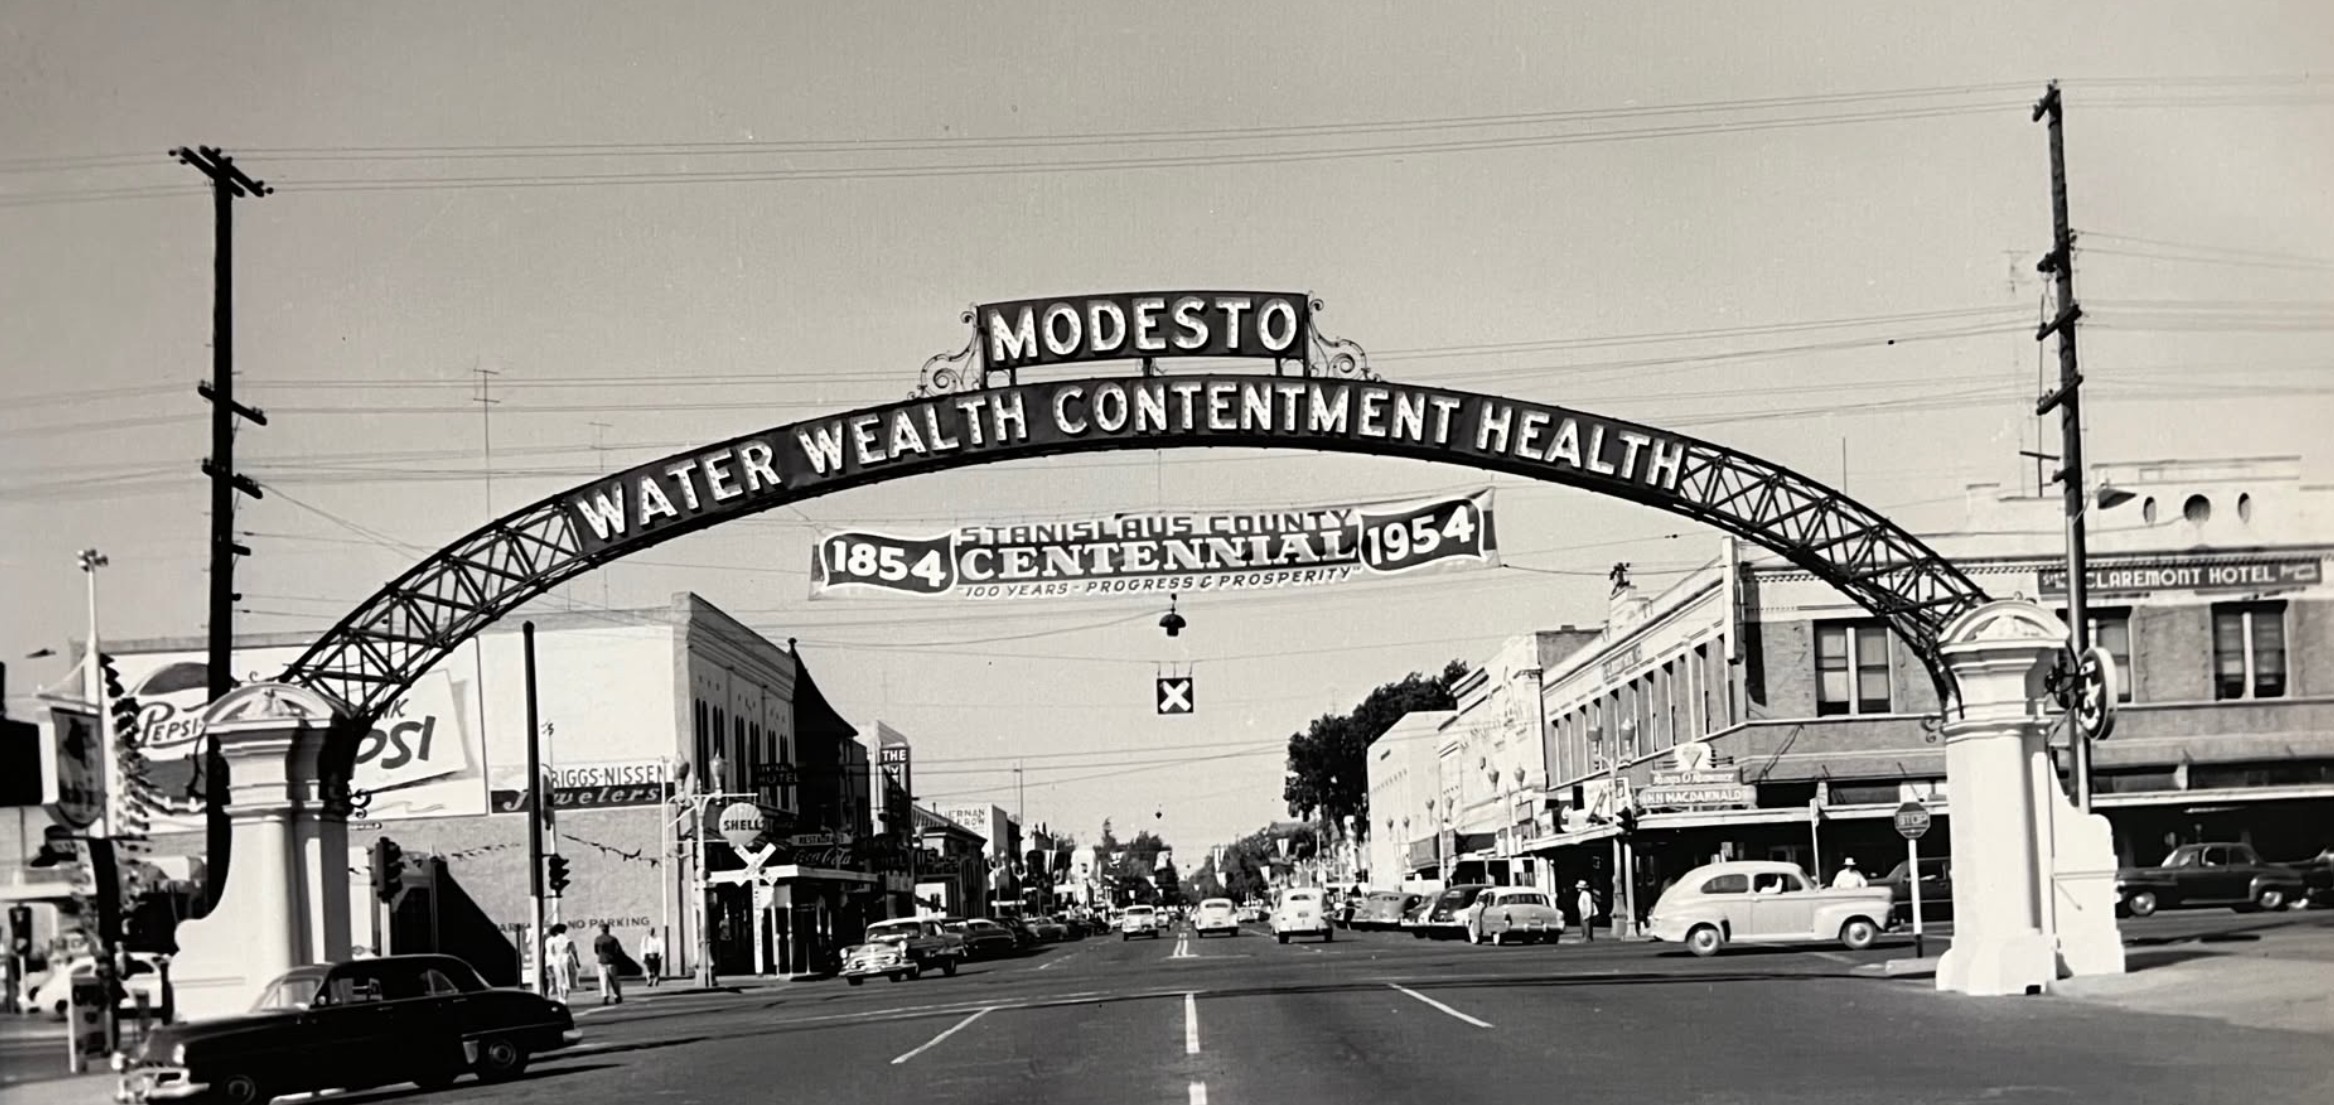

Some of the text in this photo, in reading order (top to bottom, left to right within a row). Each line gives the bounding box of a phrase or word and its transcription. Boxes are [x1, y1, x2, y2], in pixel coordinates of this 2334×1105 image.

[988, 297, 1298, 362] MODESTO
[577, 381, 1688, 540] WATER WEALTH CONTENTMENT HEALTH
[959, 509, 1352, 545] STANISLAUS COUNTY
[1366, 504, 1475, 566] 1954
[832, 540, 947, 588] 1854
[959, 530, 1357, 581] CENTENNIAL
[1007, 583, 1067, 597] YEARS
[1085, 576, 1193, 593] PROGRESS
[2208, 565, 2276, 584] HOTEL
[882, 749, 907, 762] THE
[502, 787, 660, 811] Jwelers
[723, 819, 764, 832] SHELL
[567, 916, 651, 930] NO PARKING
